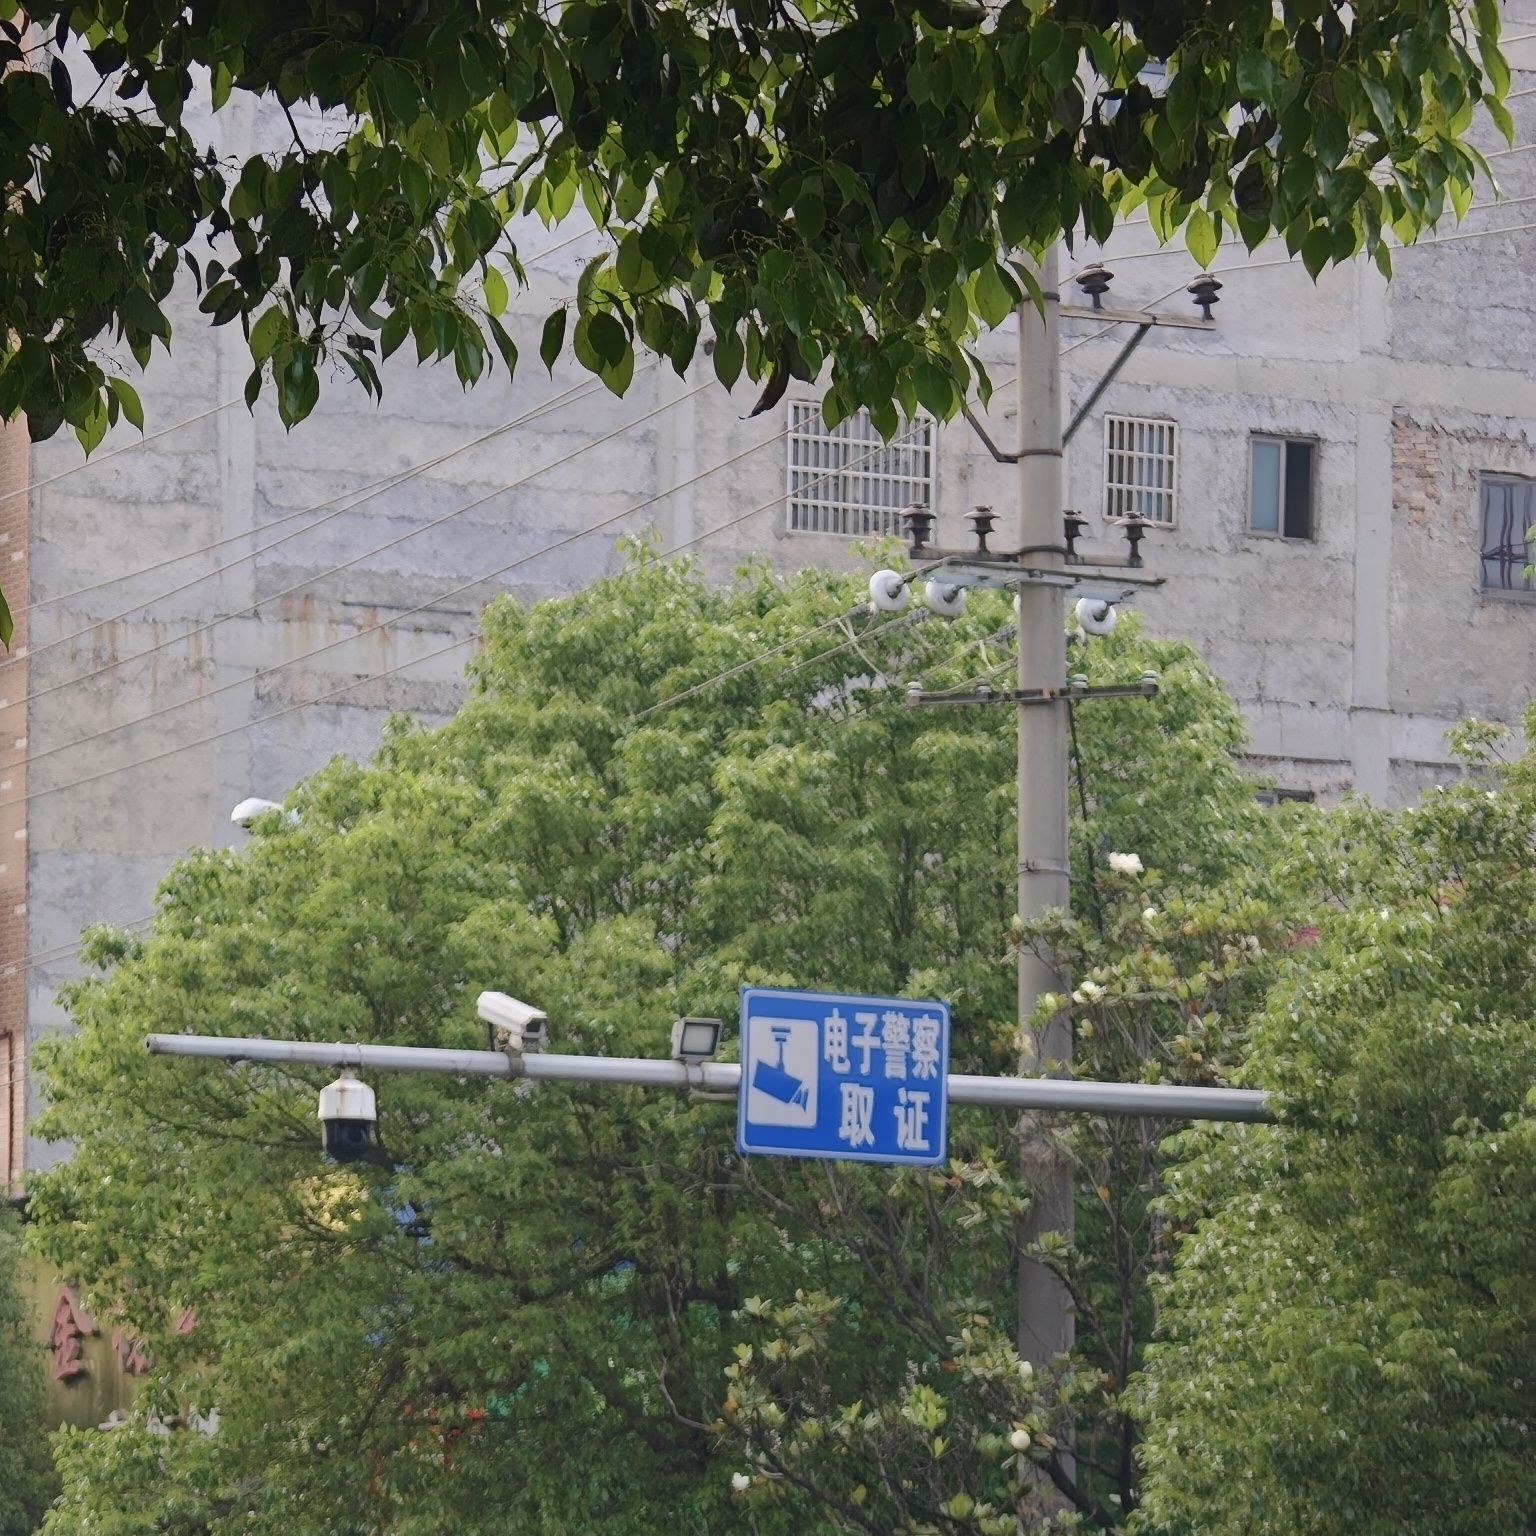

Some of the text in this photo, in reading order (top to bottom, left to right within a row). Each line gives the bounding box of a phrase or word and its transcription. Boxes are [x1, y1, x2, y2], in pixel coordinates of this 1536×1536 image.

[823, 1007, 940, 1081] 电子警察
[838, 1082, 931, 1151] 取证
